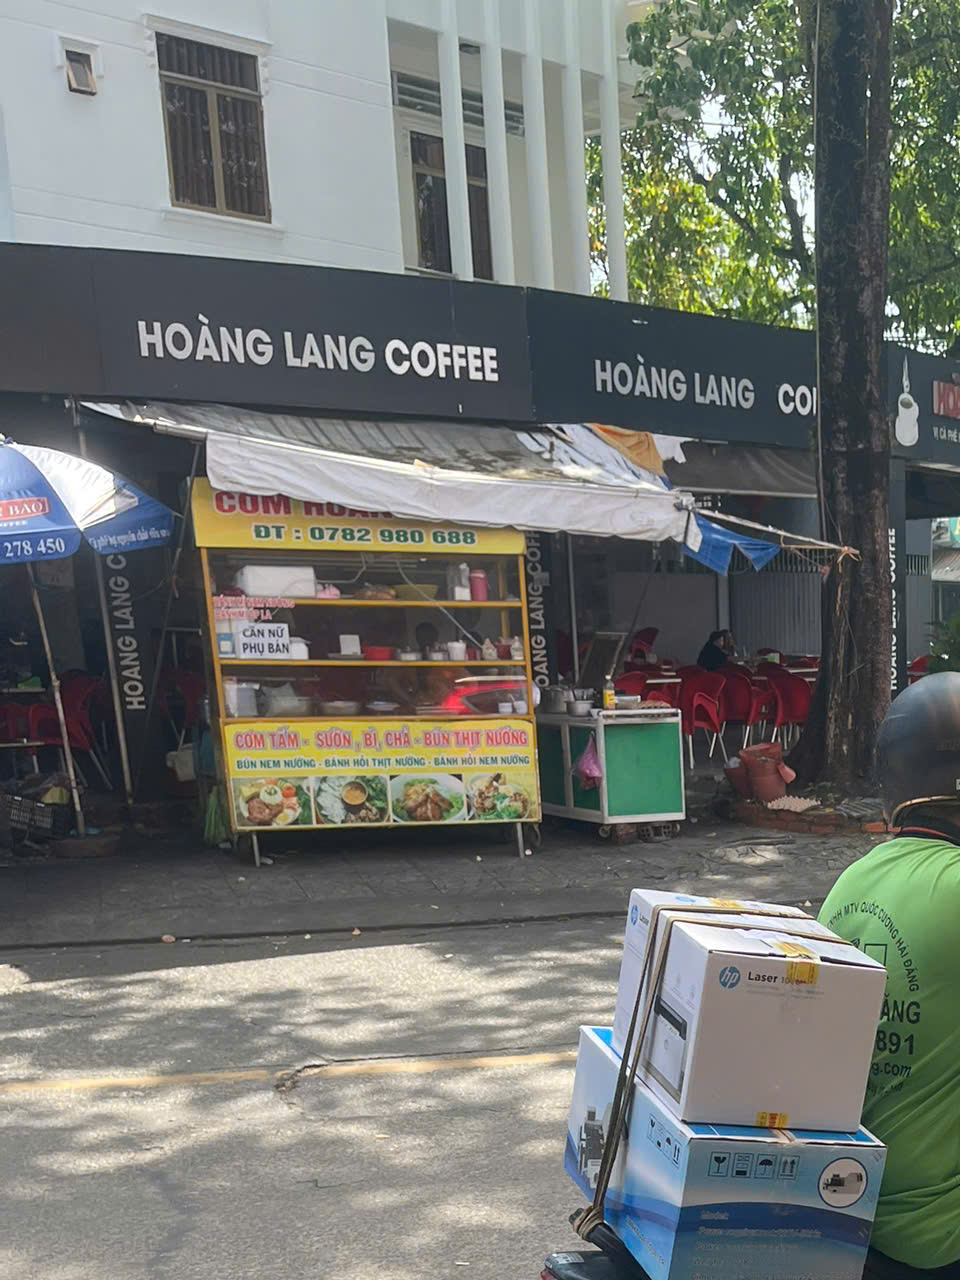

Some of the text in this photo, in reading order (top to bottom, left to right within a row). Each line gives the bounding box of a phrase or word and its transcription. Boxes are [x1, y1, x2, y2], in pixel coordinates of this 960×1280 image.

[138, 313, 499, 382] HOÀNG LANG COFFEE
[595, 354, 687, 401] HOÀNG
[694, 372, 755, 409] LANG
[4, 537, 65, 557] 278 450
[254, 525, 285, 540] ĐT
[310, 527, 371, 542] 0782
[380, 529, 424, 543] 980
[432, 530, 476, 545] 688
[109, 575, 135, 629] LANG
[528, 583, 545, 630] LANG
[530, 633, 549, 689] OANG
[260, 759, 280, 769] NEM
[479, 757, 498, 766] NEM
[844, 902, 859, 916] MTV
[719, 966, 741, 989] hp
[748, 972, 778, 983] Laser
[880, 993, 920, 1024] ĂNG
